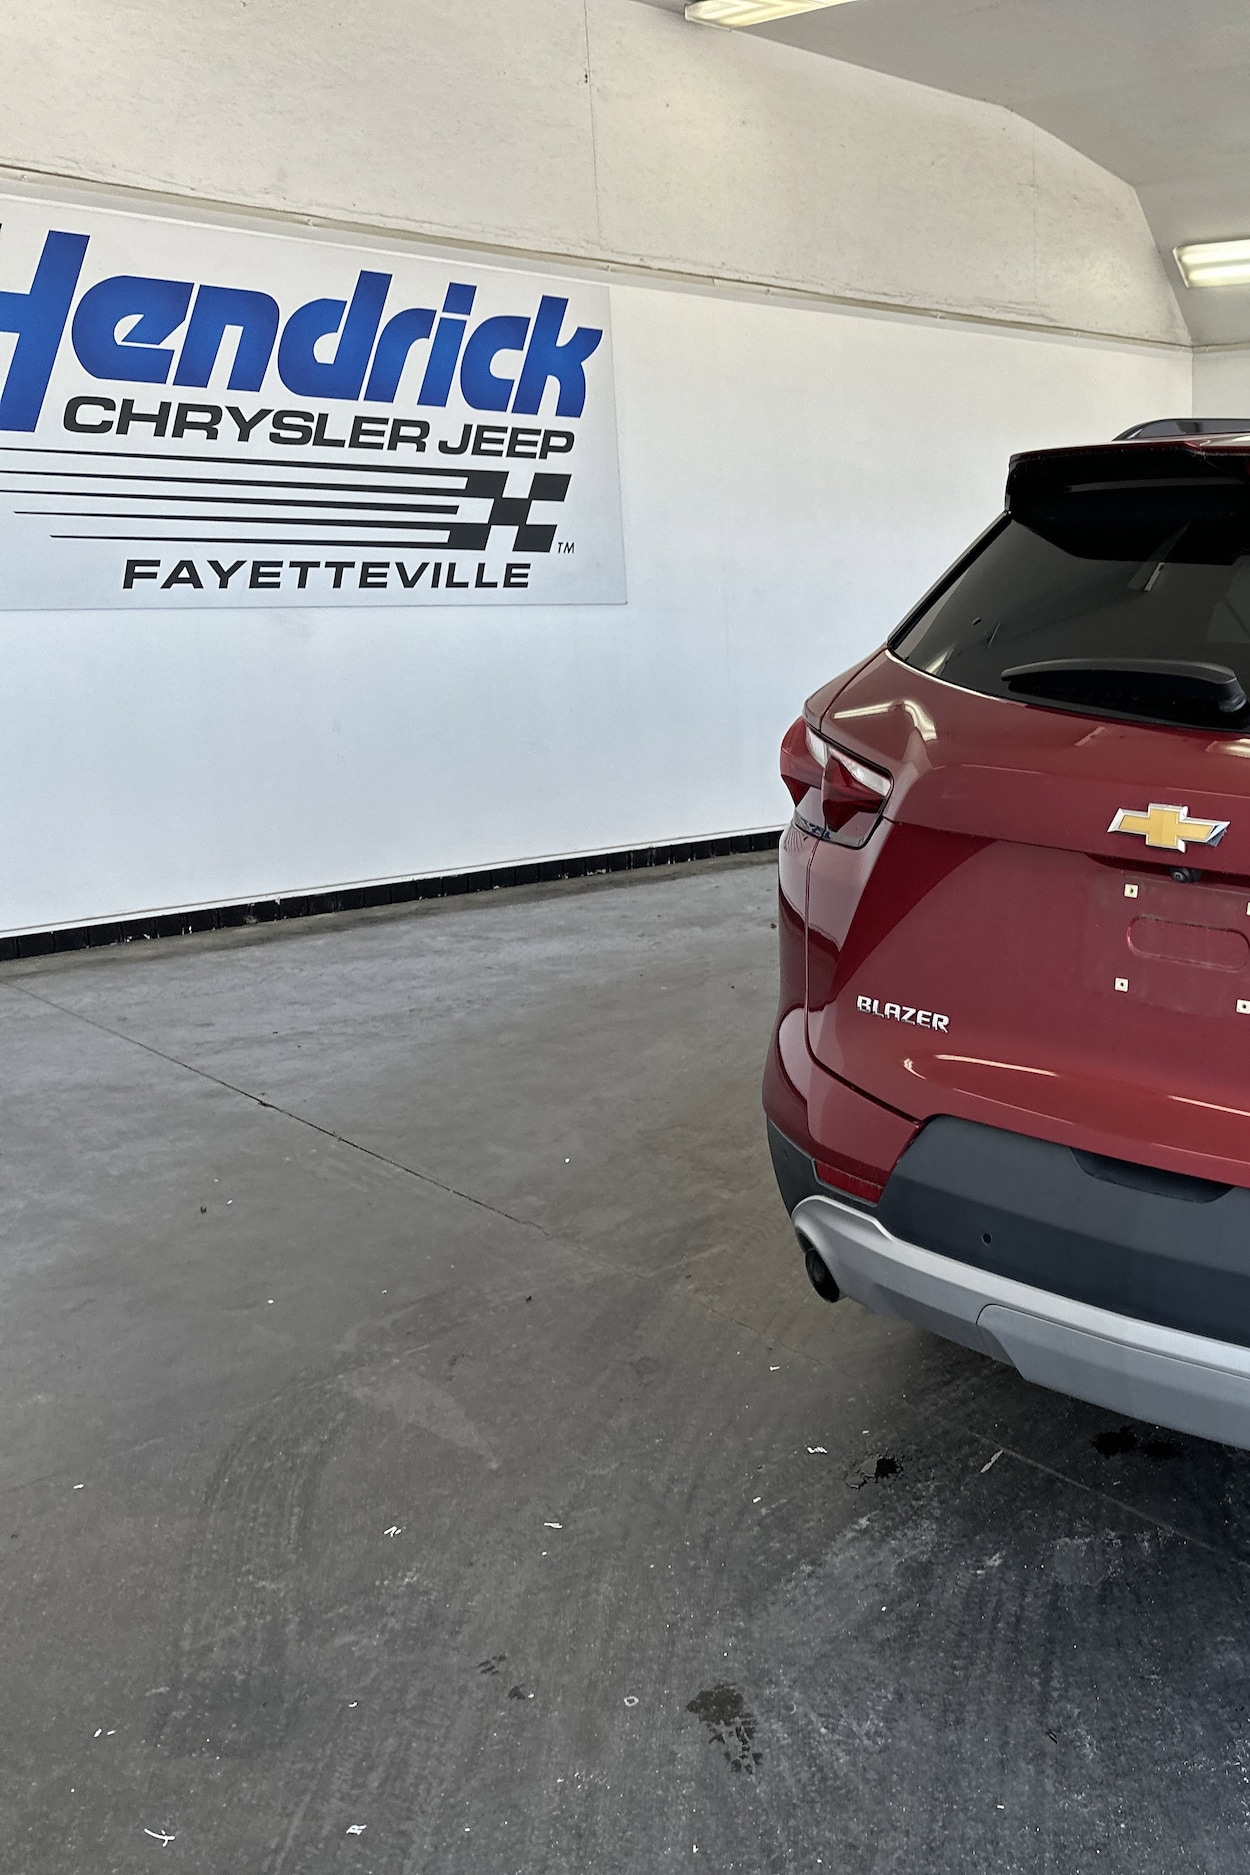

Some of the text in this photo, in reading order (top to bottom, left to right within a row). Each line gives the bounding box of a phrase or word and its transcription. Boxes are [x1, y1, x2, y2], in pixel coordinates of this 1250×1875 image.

[0, 229, 603, 433] Hendrick
[63, 396, 575, 459] CHRYSLER JEEP
[557, 541, 575, 554] TM
[122, 559, 531, 589] FAYETTEVILLE
[856, 995, 950, 1034] BLAZER
